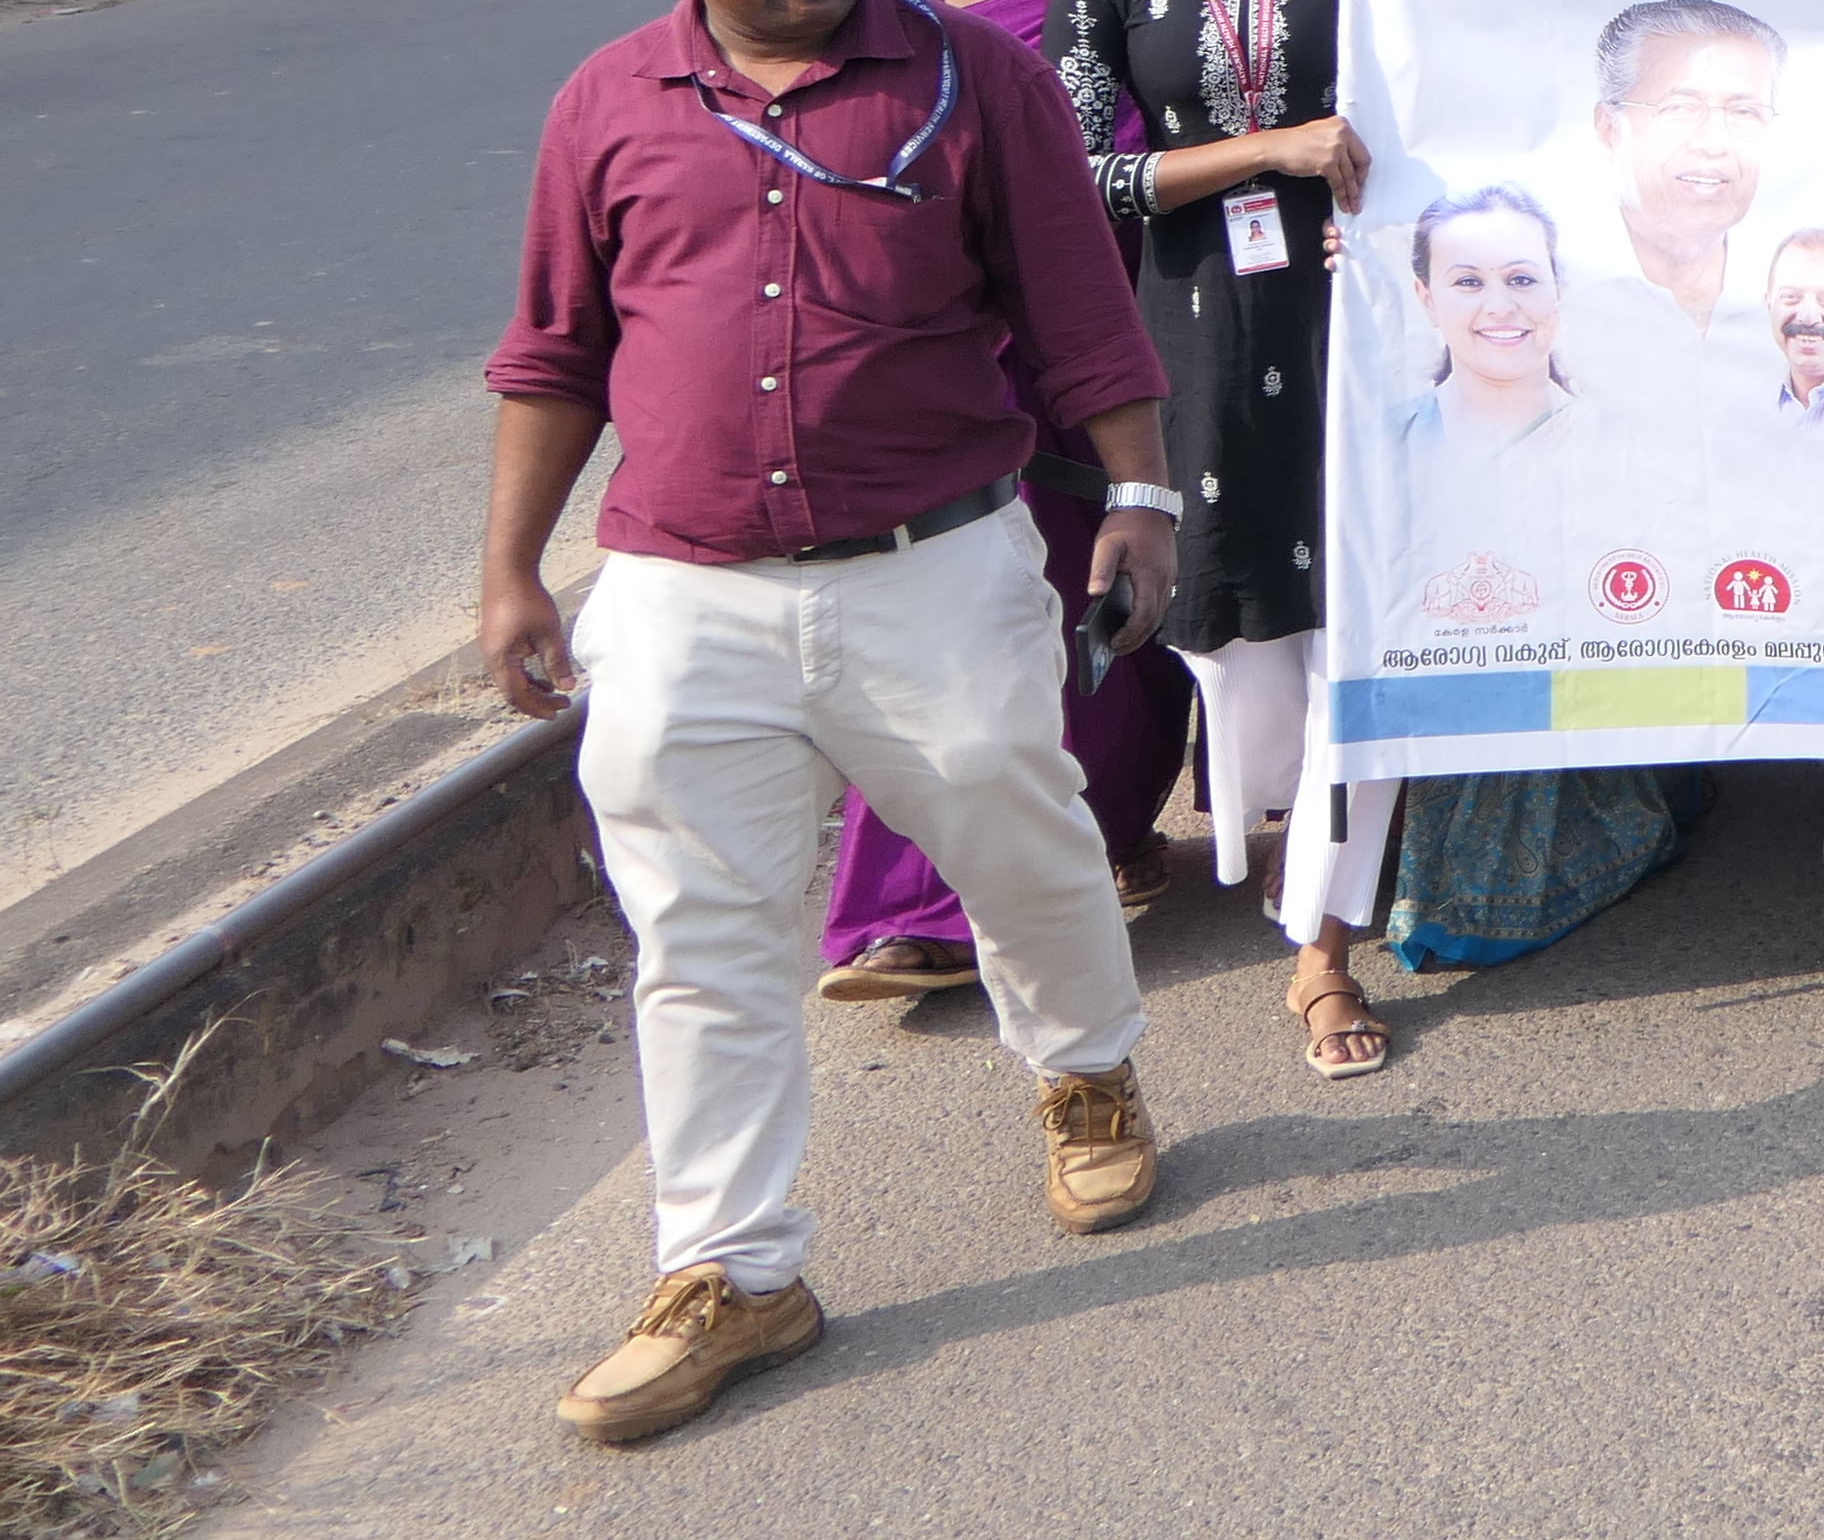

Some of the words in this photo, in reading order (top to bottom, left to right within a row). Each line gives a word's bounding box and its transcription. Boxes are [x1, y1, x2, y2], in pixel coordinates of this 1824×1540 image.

[1433, 626, 1470, 639] കേരള
[1474, 621, 1529, 637] സർക്കാർ
[1382, 646, 1488, 671] ആരോഗ്യ
[1580, 637, 1758, 663] ആരോഗ്യകേരളം
